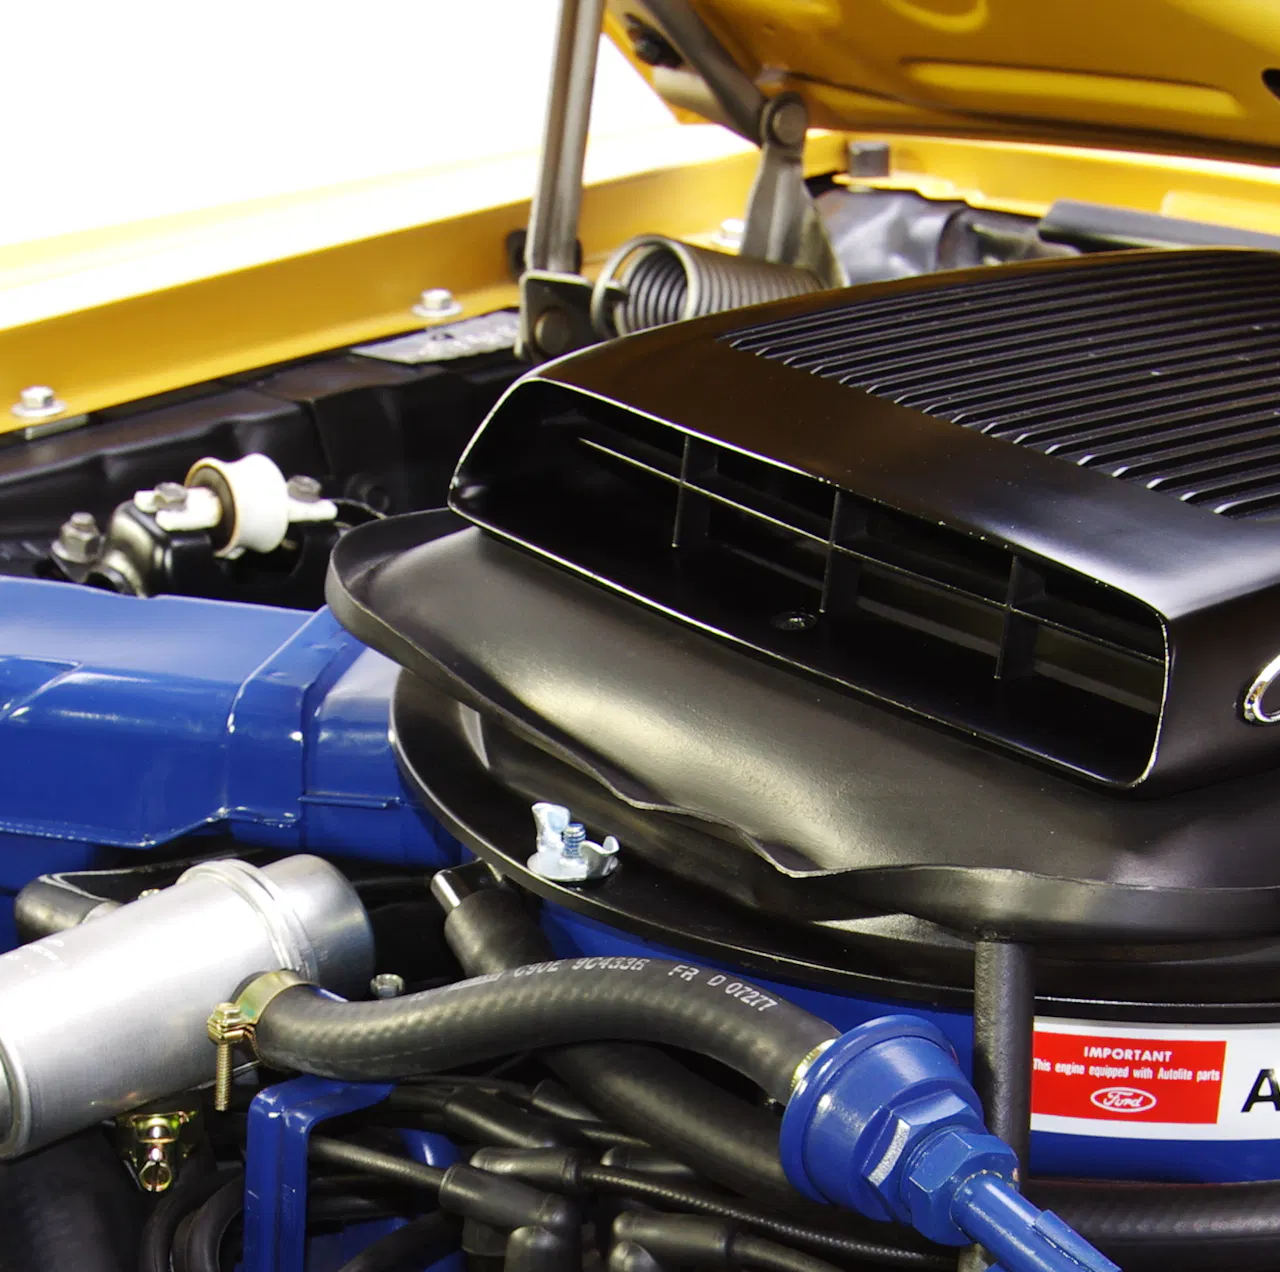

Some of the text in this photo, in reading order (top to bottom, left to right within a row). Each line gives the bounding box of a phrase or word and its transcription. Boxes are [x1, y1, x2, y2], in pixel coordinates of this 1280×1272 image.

[668, 964, 700, 981] FR
[725, 982, 778, 1012] 07277
[1084, 1046, 1173, 1063] IMPORTANT
[1033, 1058, 1221, 1083] This engine equipped with Autolite parts
[1102, 1090, 1145, 1108] Ford
